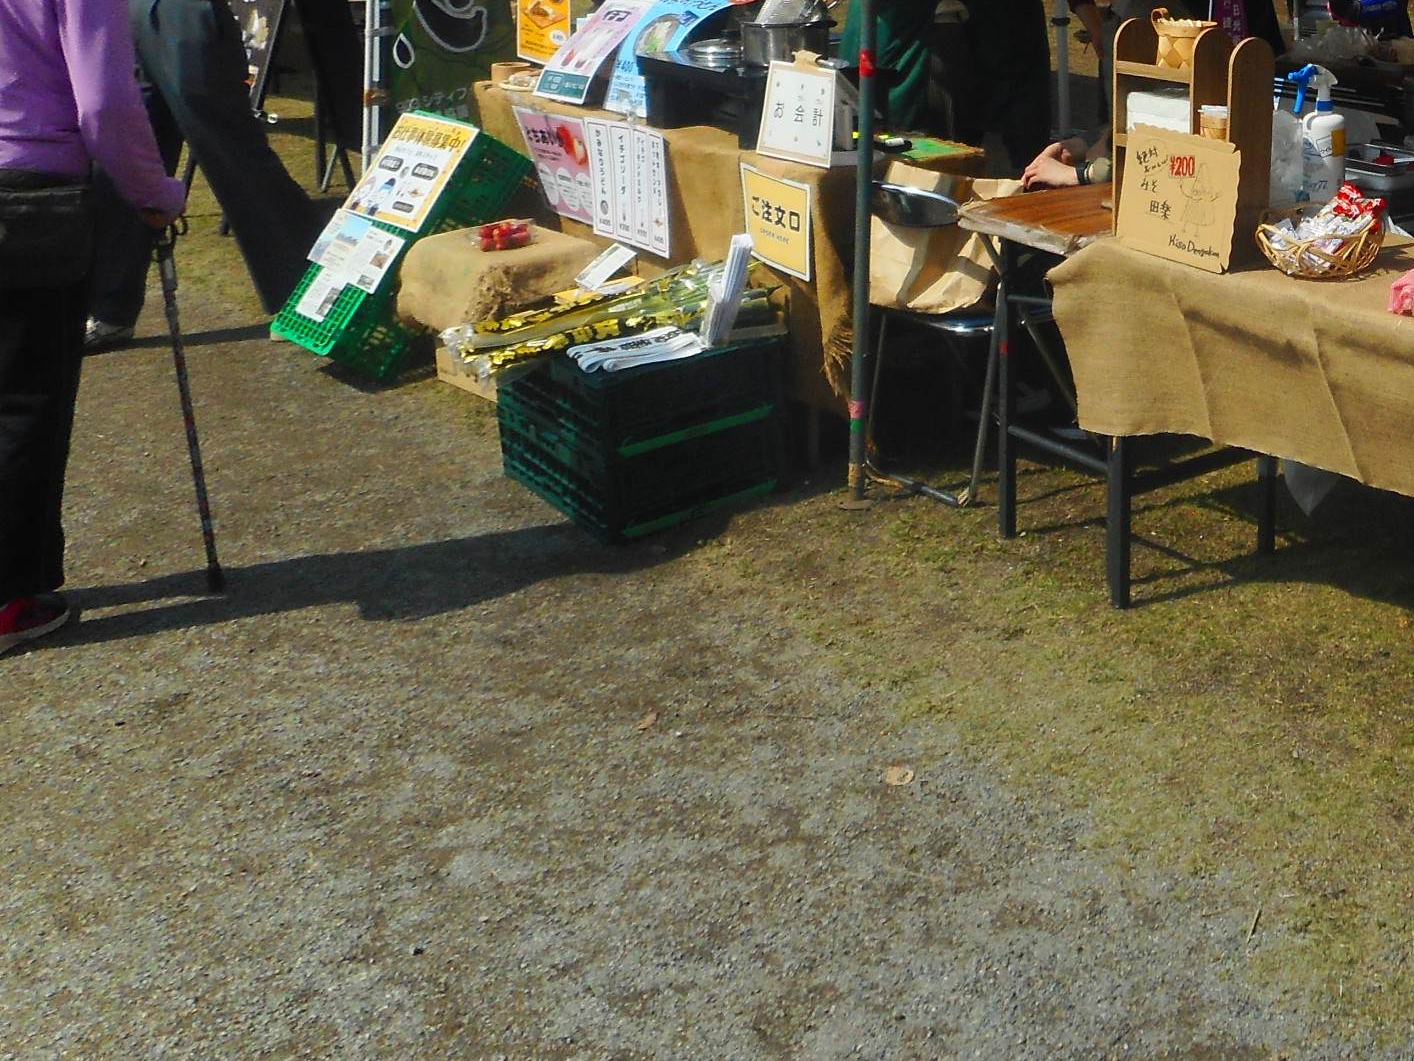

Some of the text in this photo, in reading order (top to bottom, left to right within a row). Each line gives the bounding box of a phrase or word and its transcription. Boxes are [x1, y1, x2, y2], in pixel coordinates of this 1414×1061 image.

[774, 102, 823, 128] お会計
[1170, 156, 1195, 177] ¥200
[1150, 200, 1172, 220] 田楽
